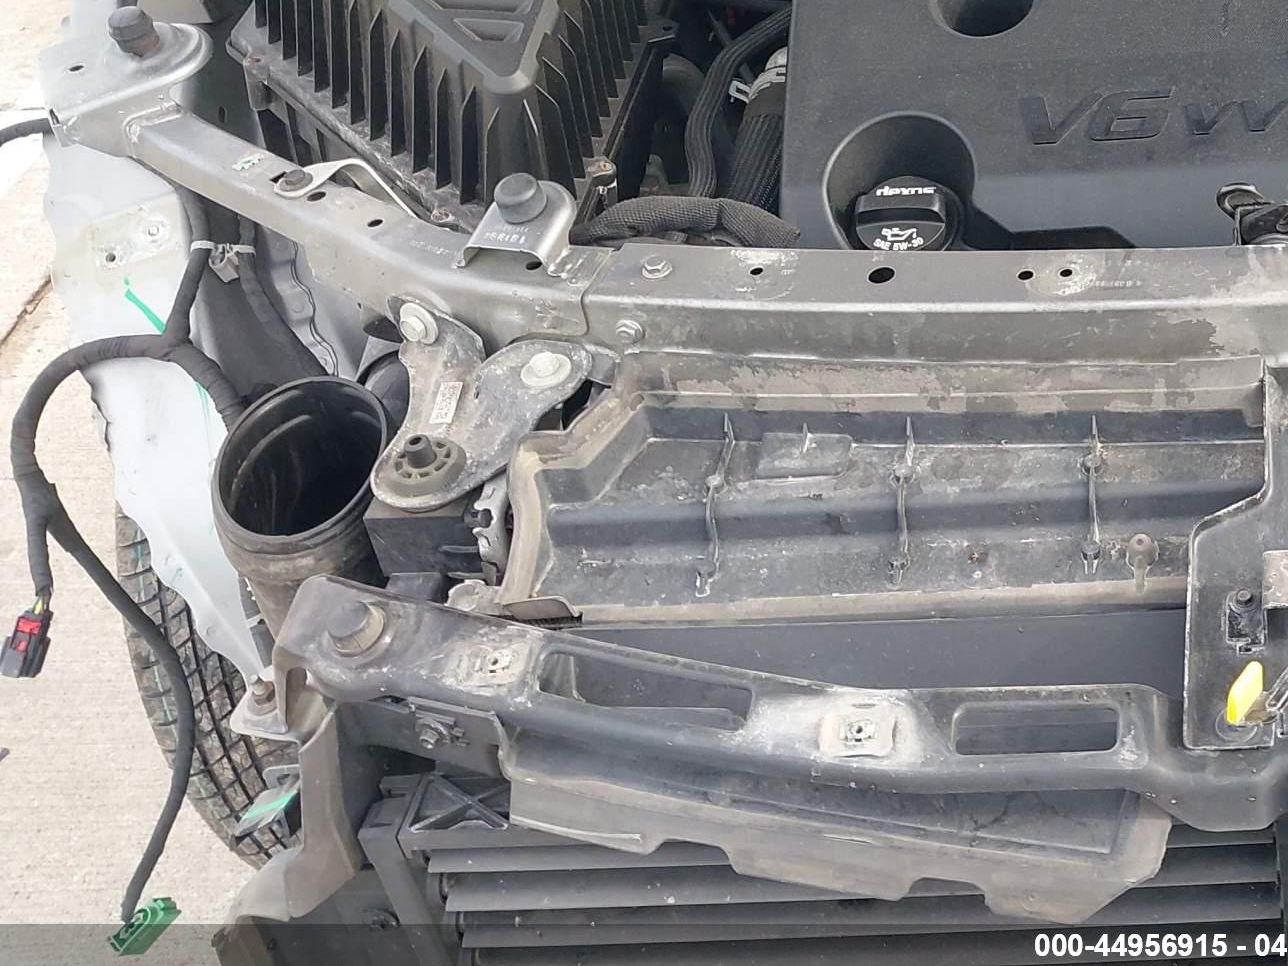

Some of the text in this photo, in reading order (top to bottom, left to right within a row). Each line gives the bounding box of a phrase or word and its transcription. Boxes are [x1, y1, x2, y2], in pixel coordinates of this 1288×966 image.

[1022, 86, 1176, 145] V6
[873, 237, 924, 251] SAE 5W-30
